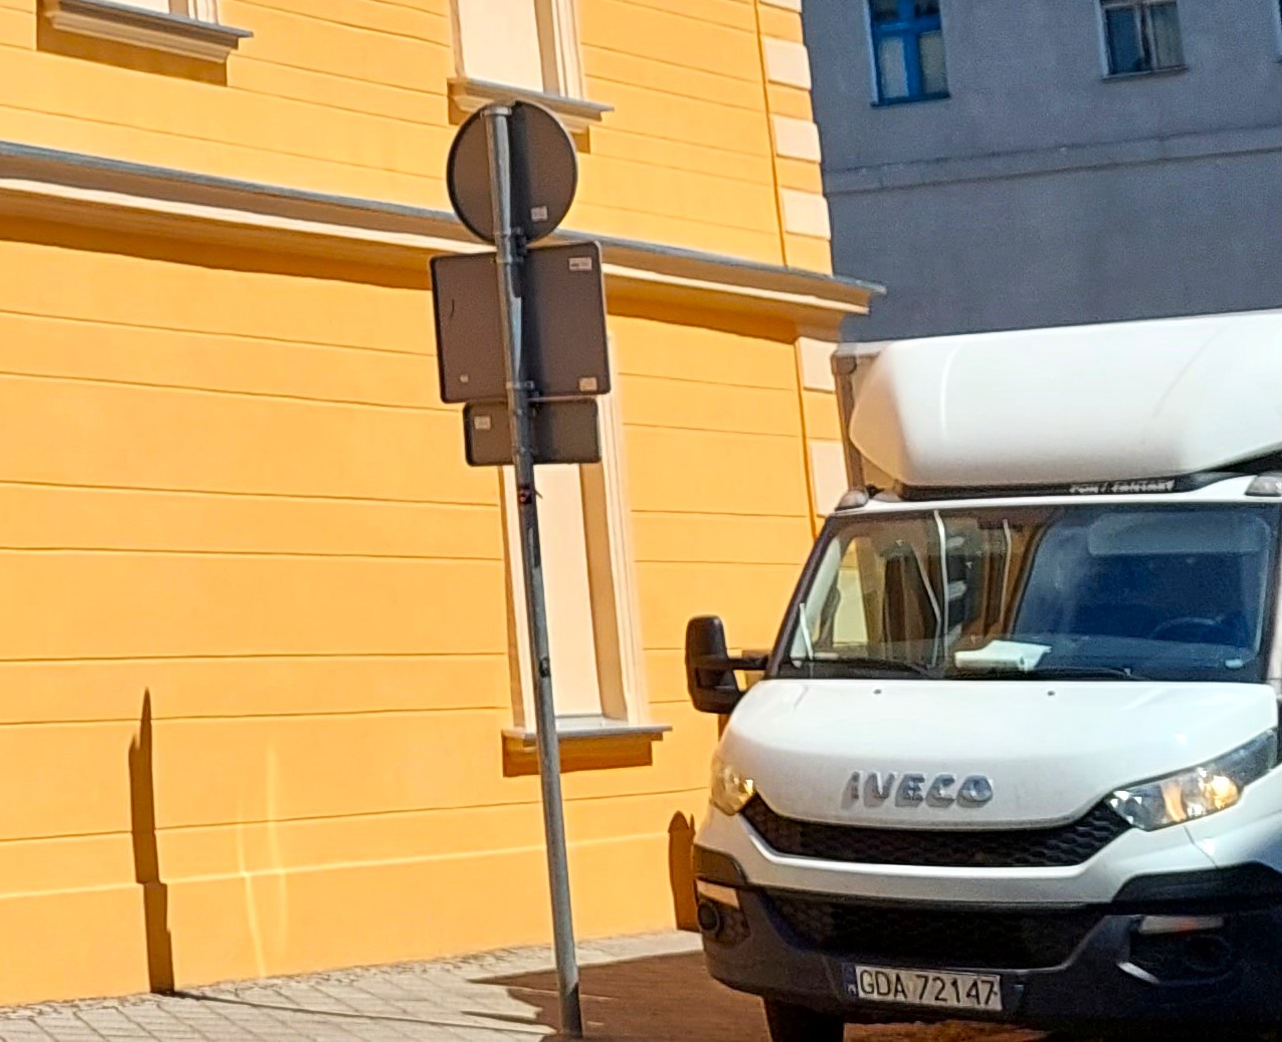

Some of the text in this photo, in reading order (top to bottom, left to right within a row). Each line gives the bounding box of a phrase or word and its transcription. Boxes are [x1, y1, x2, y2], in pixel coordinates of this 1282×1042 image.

[849, 771, 994, 806] IVECO
[860, 969, 996, 1006] GDA 72147
